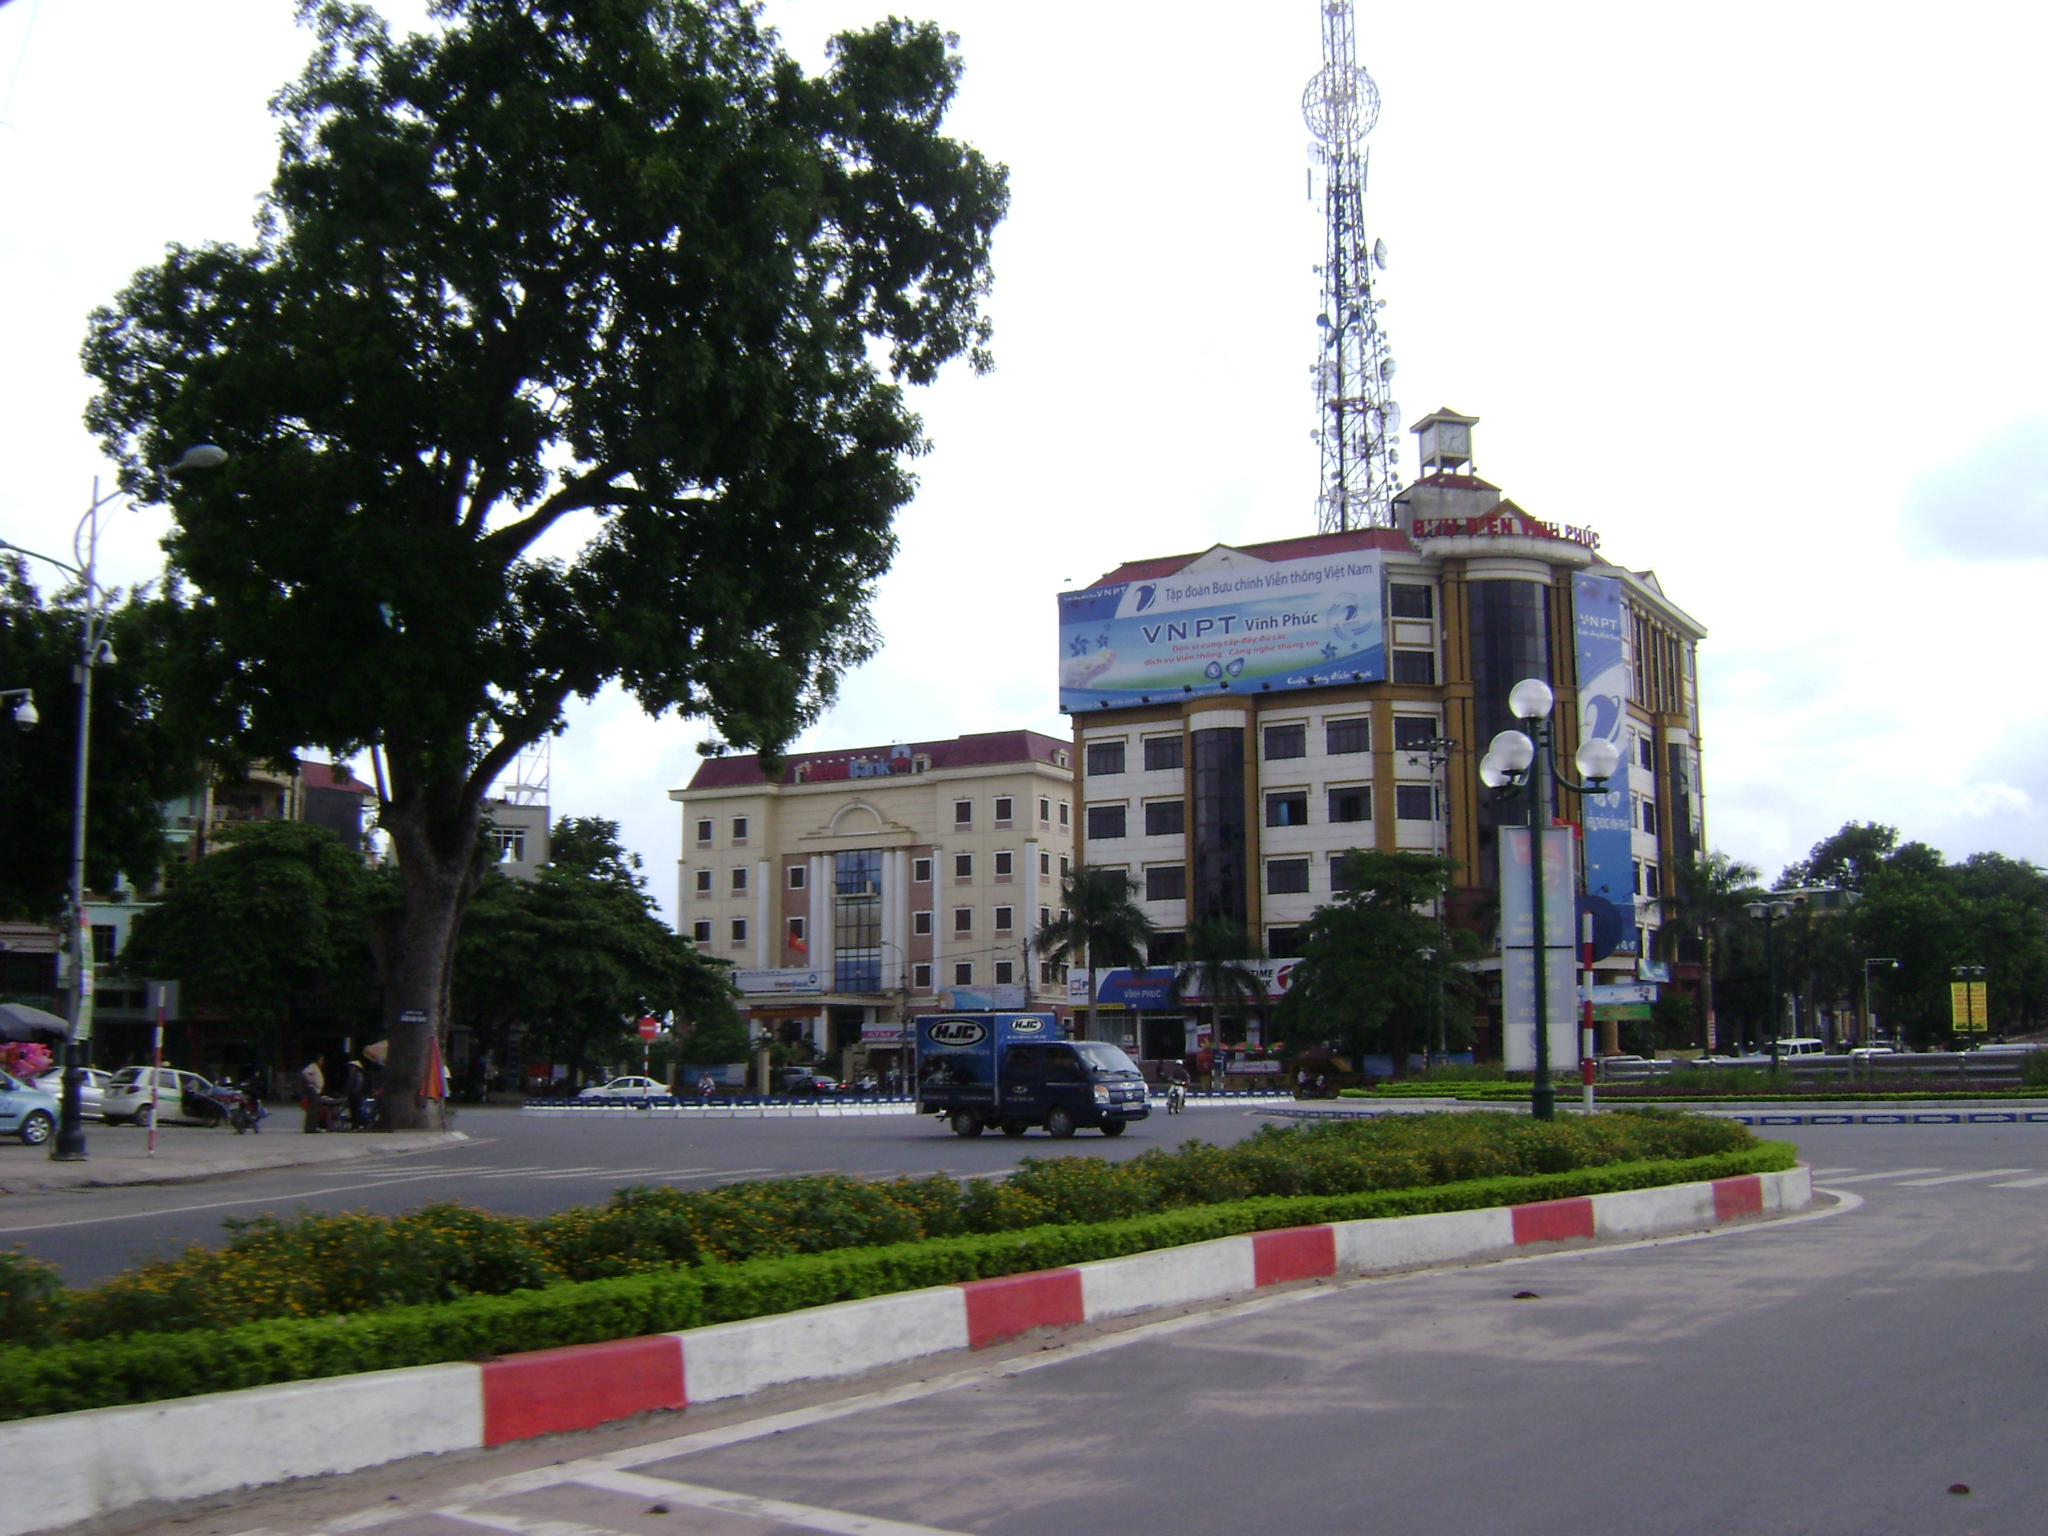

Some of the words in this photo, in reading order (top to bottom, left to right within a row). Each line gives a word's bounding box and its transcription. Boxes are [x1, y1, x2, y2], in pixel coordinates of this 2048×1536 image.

[1347, 563, 1372, 576] Nam
[1096, 587, 1126, 597] VNPT
[1142, 615, 1237, 644] VNPT
[1244, 614, 1278, 631] Vĩnh
[1282, 611, 1319, 627] Phúc
[1580, 613, 1617, 630] VNPT
[1014, 1020, 1038, 1029] HJC
[934, 1025, 976, 1039] HJC
